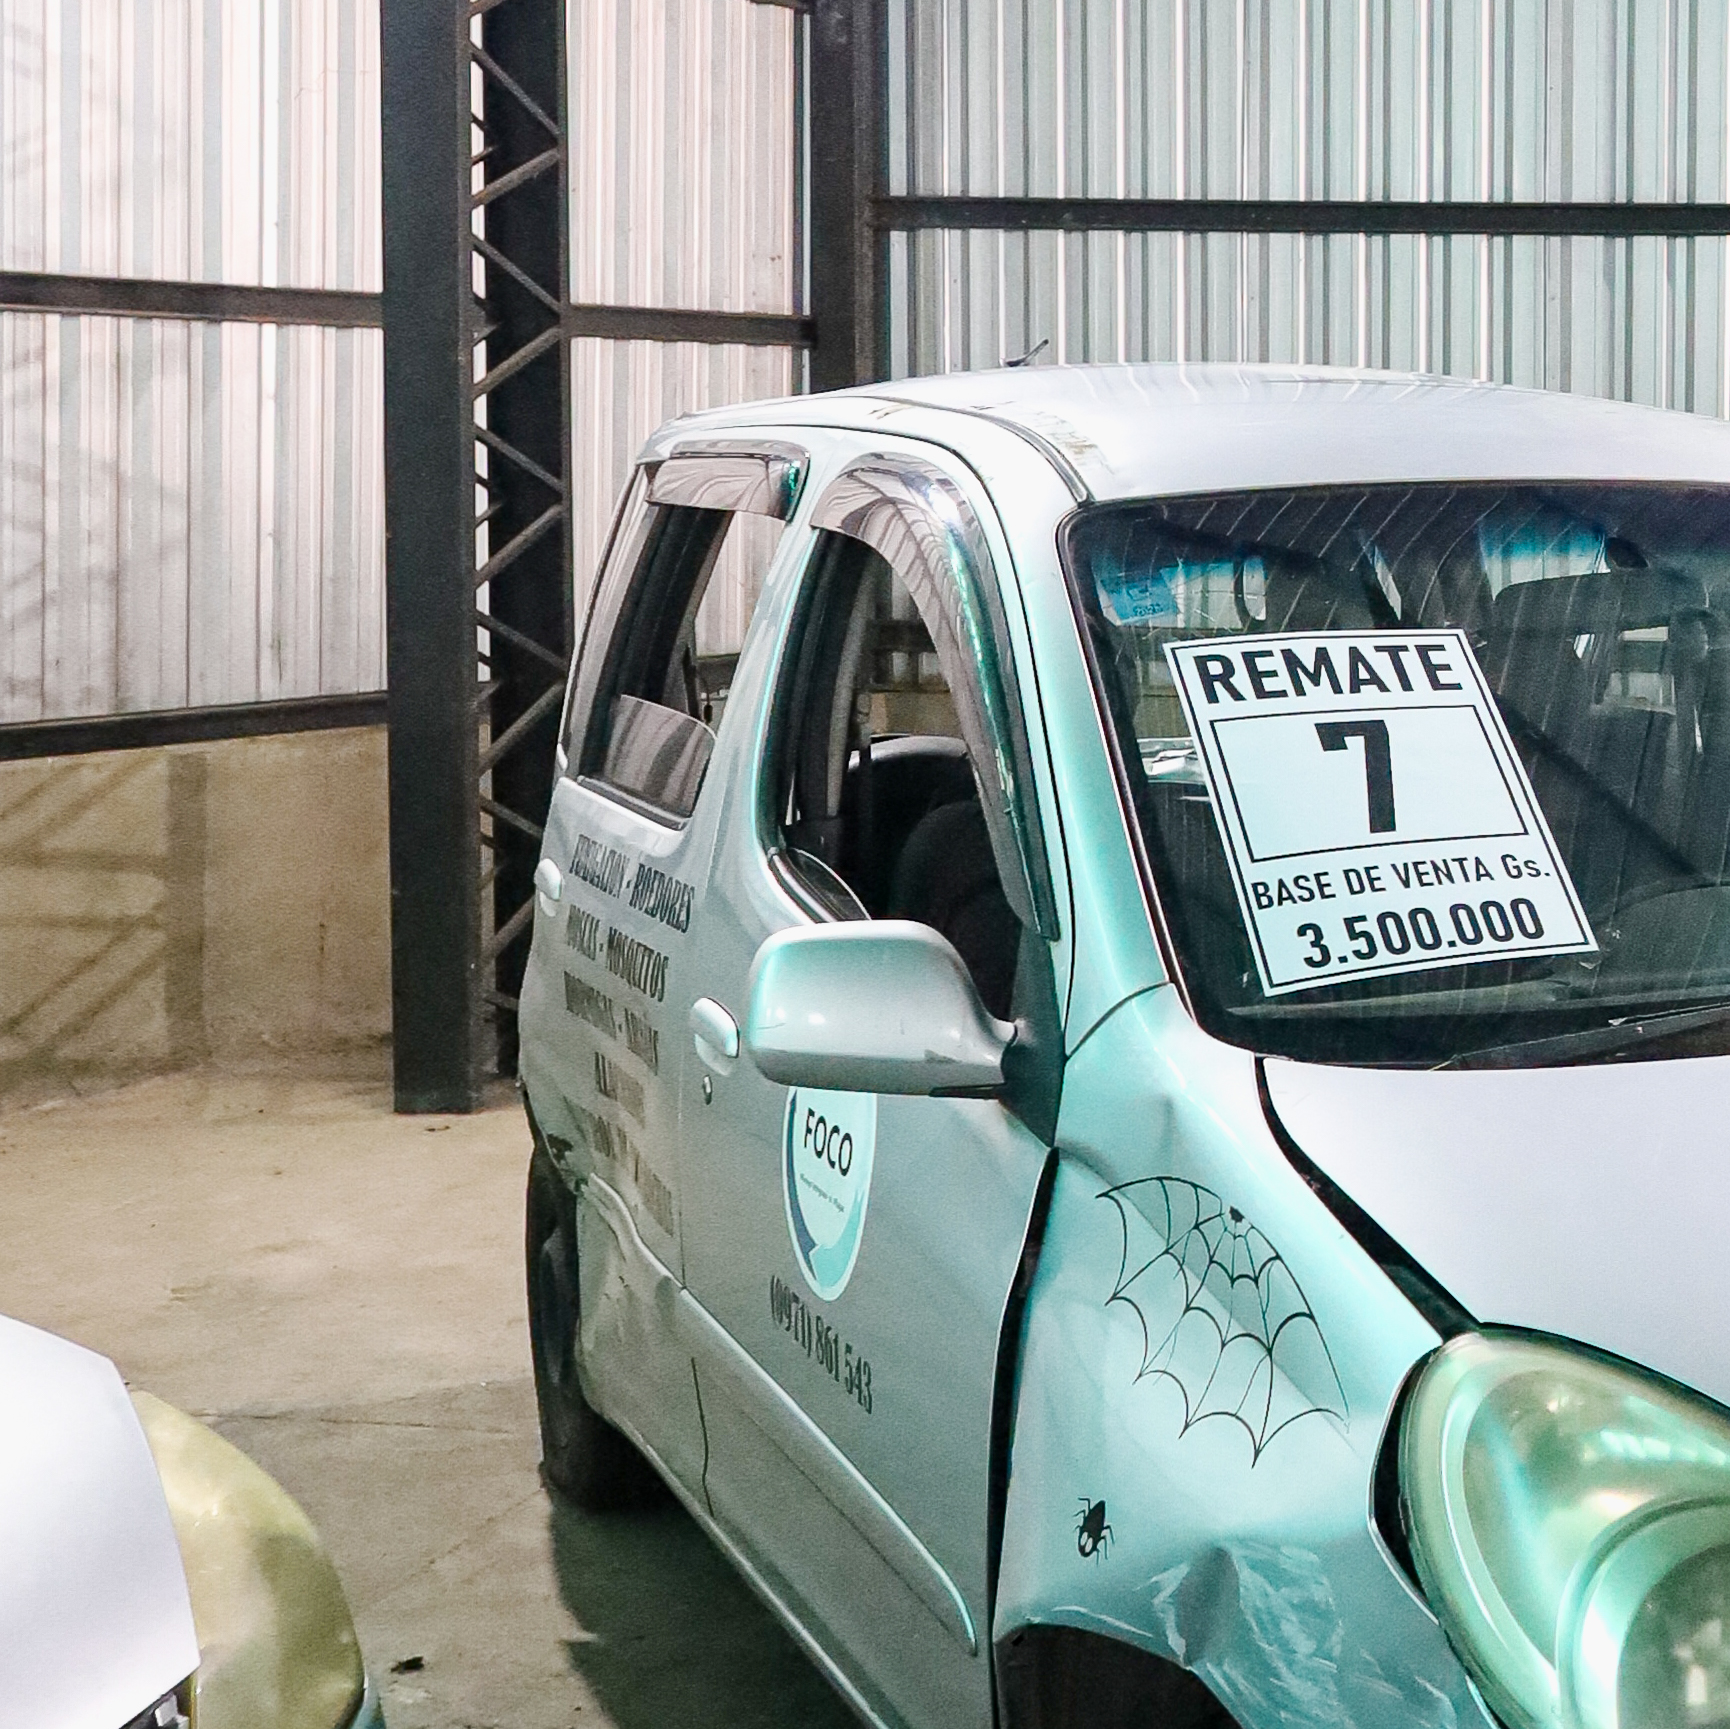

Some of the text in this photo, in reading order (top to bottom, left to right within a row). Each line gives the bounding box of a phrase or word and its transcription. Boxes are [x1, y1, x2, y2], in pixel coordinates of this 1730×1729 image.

[1193, 644, 1463, 705] REMATE
[1313, 719, 1397, 835] 7
[629, 862, 695, 934] ROEDORES
[1252, 853, 1551, 910] BASE DE VENTA Gs.
[1296, 897, 1545, 969] 3.500.000
[804, 1106, 853, 1177] FOCO
[770, 1274, 873, 1415] (0971) 861 543
